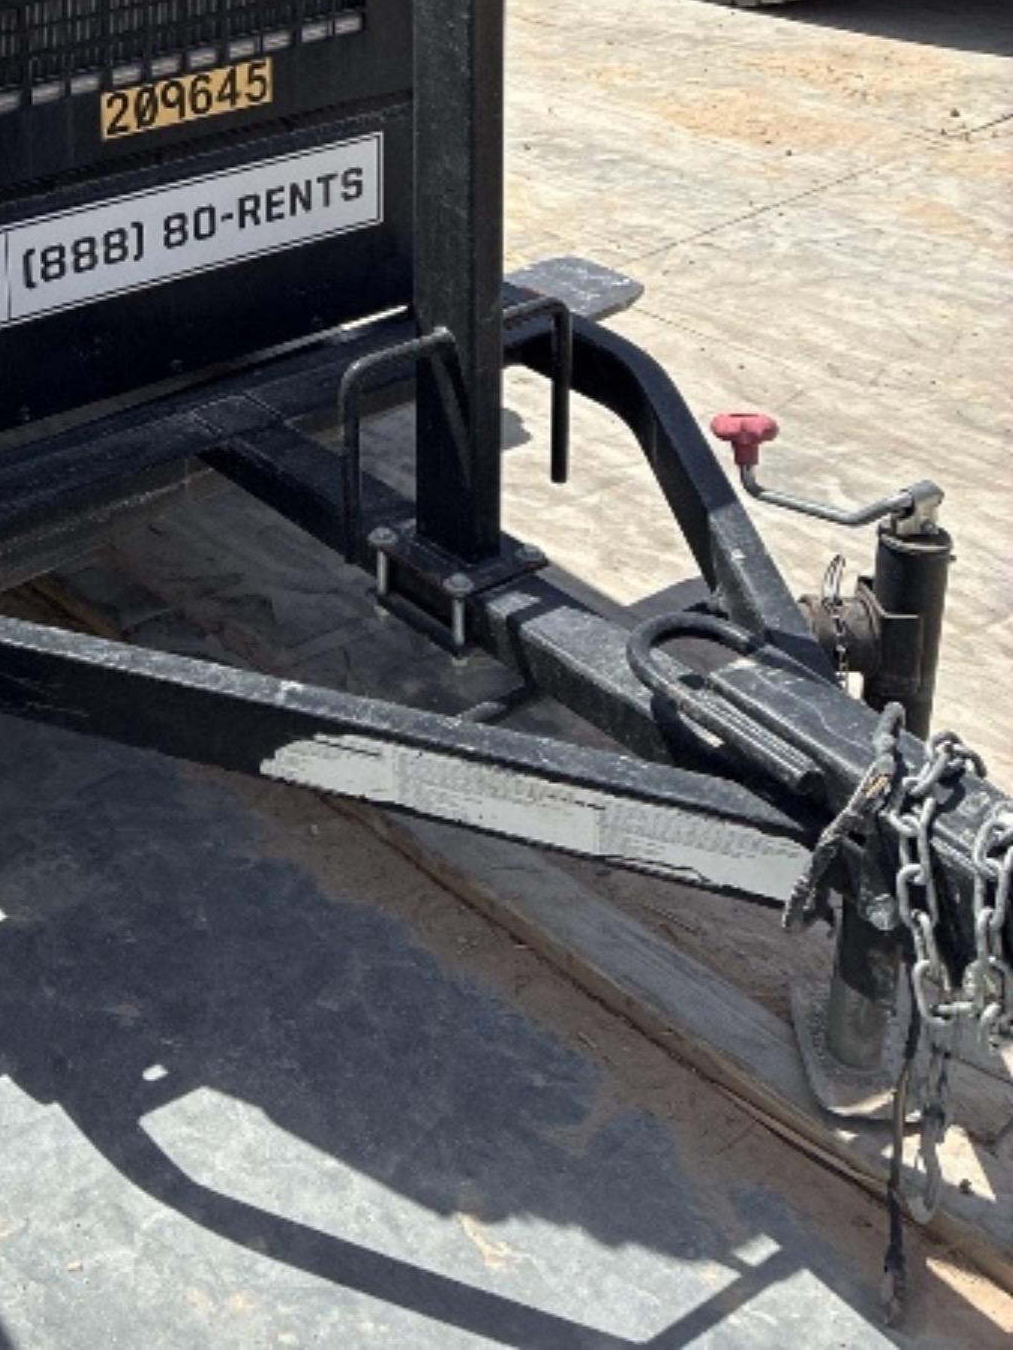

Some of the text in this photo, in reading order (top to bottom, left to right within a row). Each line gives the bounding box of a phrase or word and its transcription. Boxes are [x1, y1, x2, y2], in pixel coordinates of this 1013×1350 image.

[105, 61, 270, 135] 209645
[21, 166, 364, 290] (888) 80-RENTS
